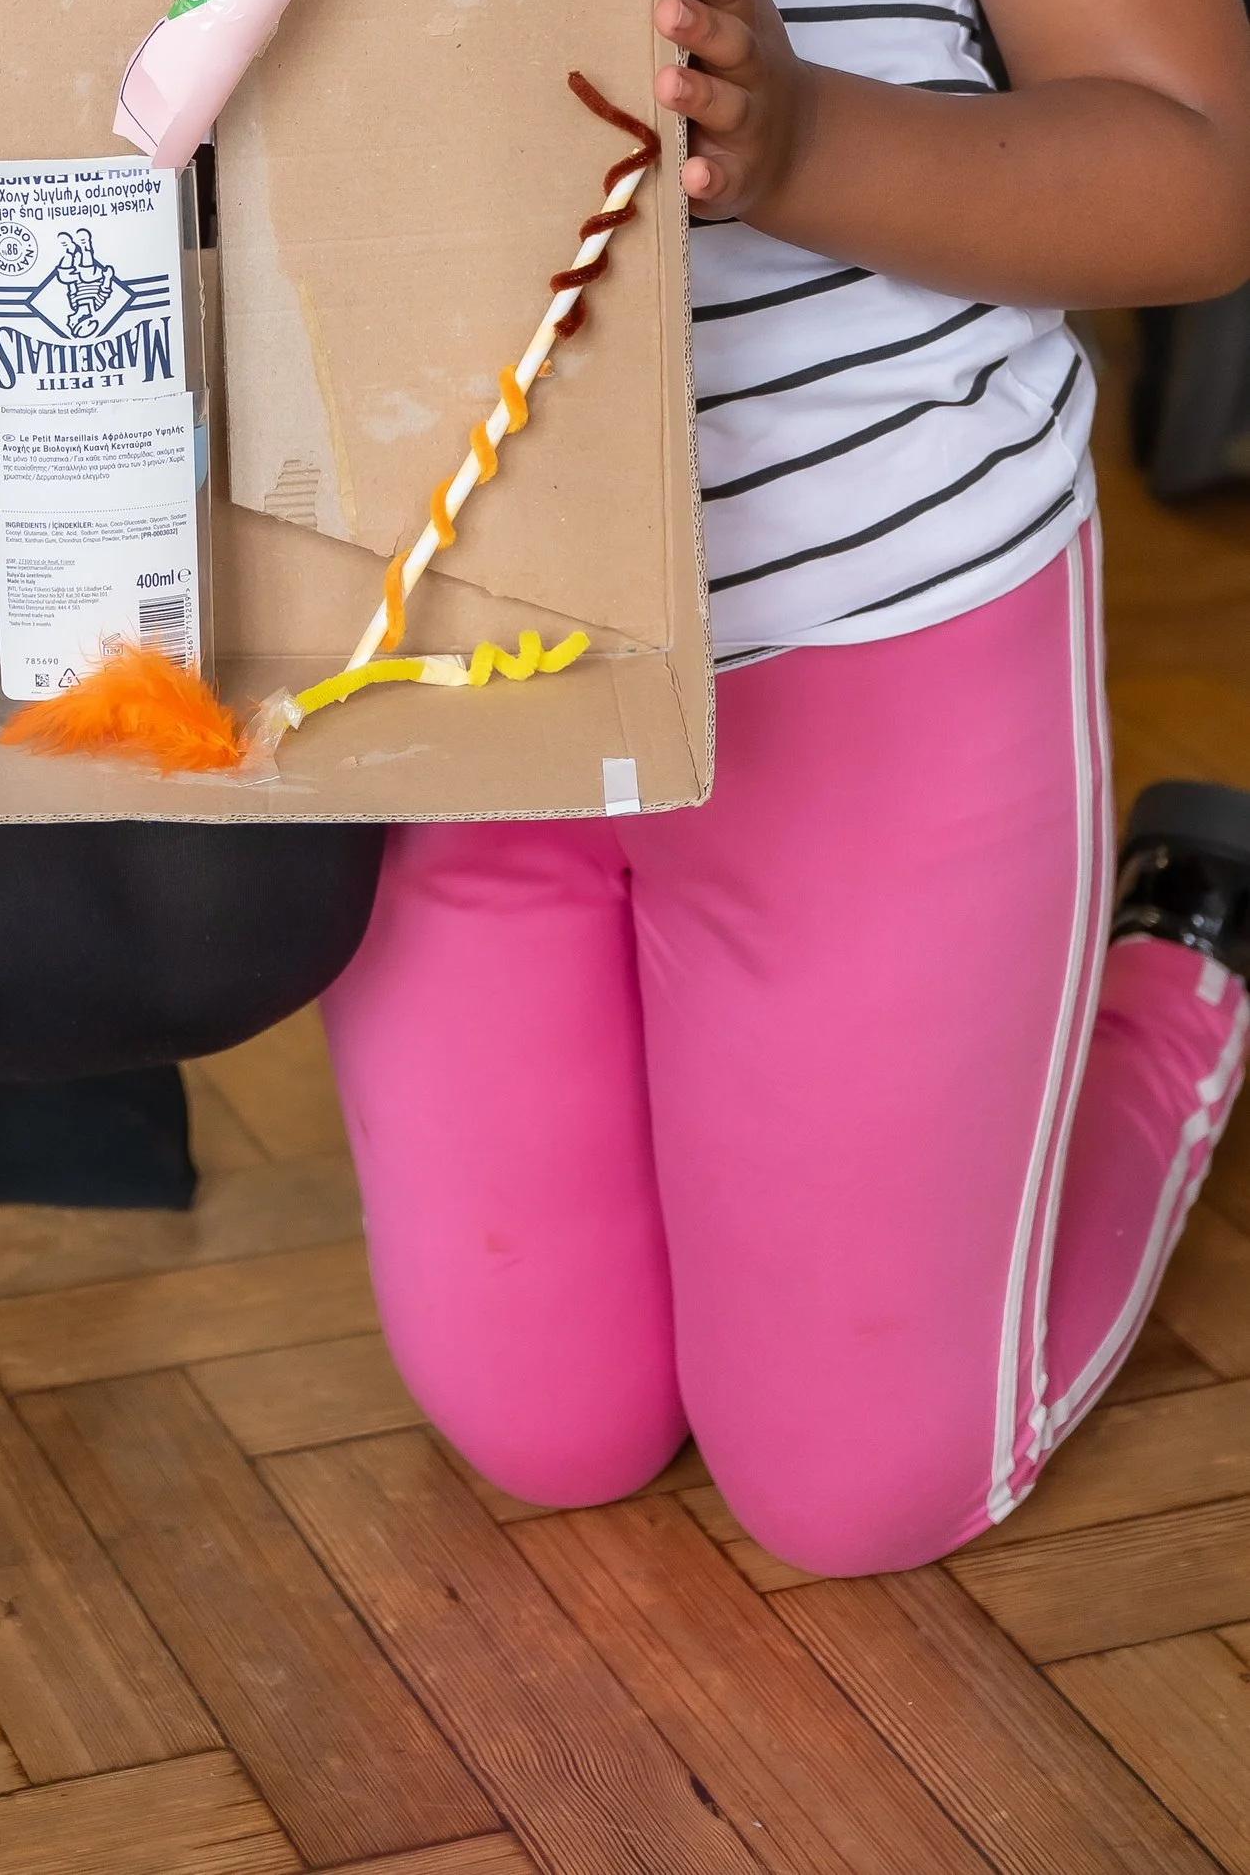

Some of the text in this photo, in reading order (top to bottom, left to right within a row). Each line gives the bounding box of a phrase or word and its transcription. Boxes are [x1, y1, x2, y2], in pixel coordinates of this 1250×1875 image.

[20, 205, 43, 221] Duş
[47, 203, 107, 219] Toleranslı
[111, 197, 154, 213] Yüksek
[36, 373, 124, 391] LE PETIT
[54, 434, 99, 442] Marseillais
[5, 521, 47, 529] INGREDIENTS
[136, 569, 174, 588] 400ml
[25, 657, 59, 665] 785690
